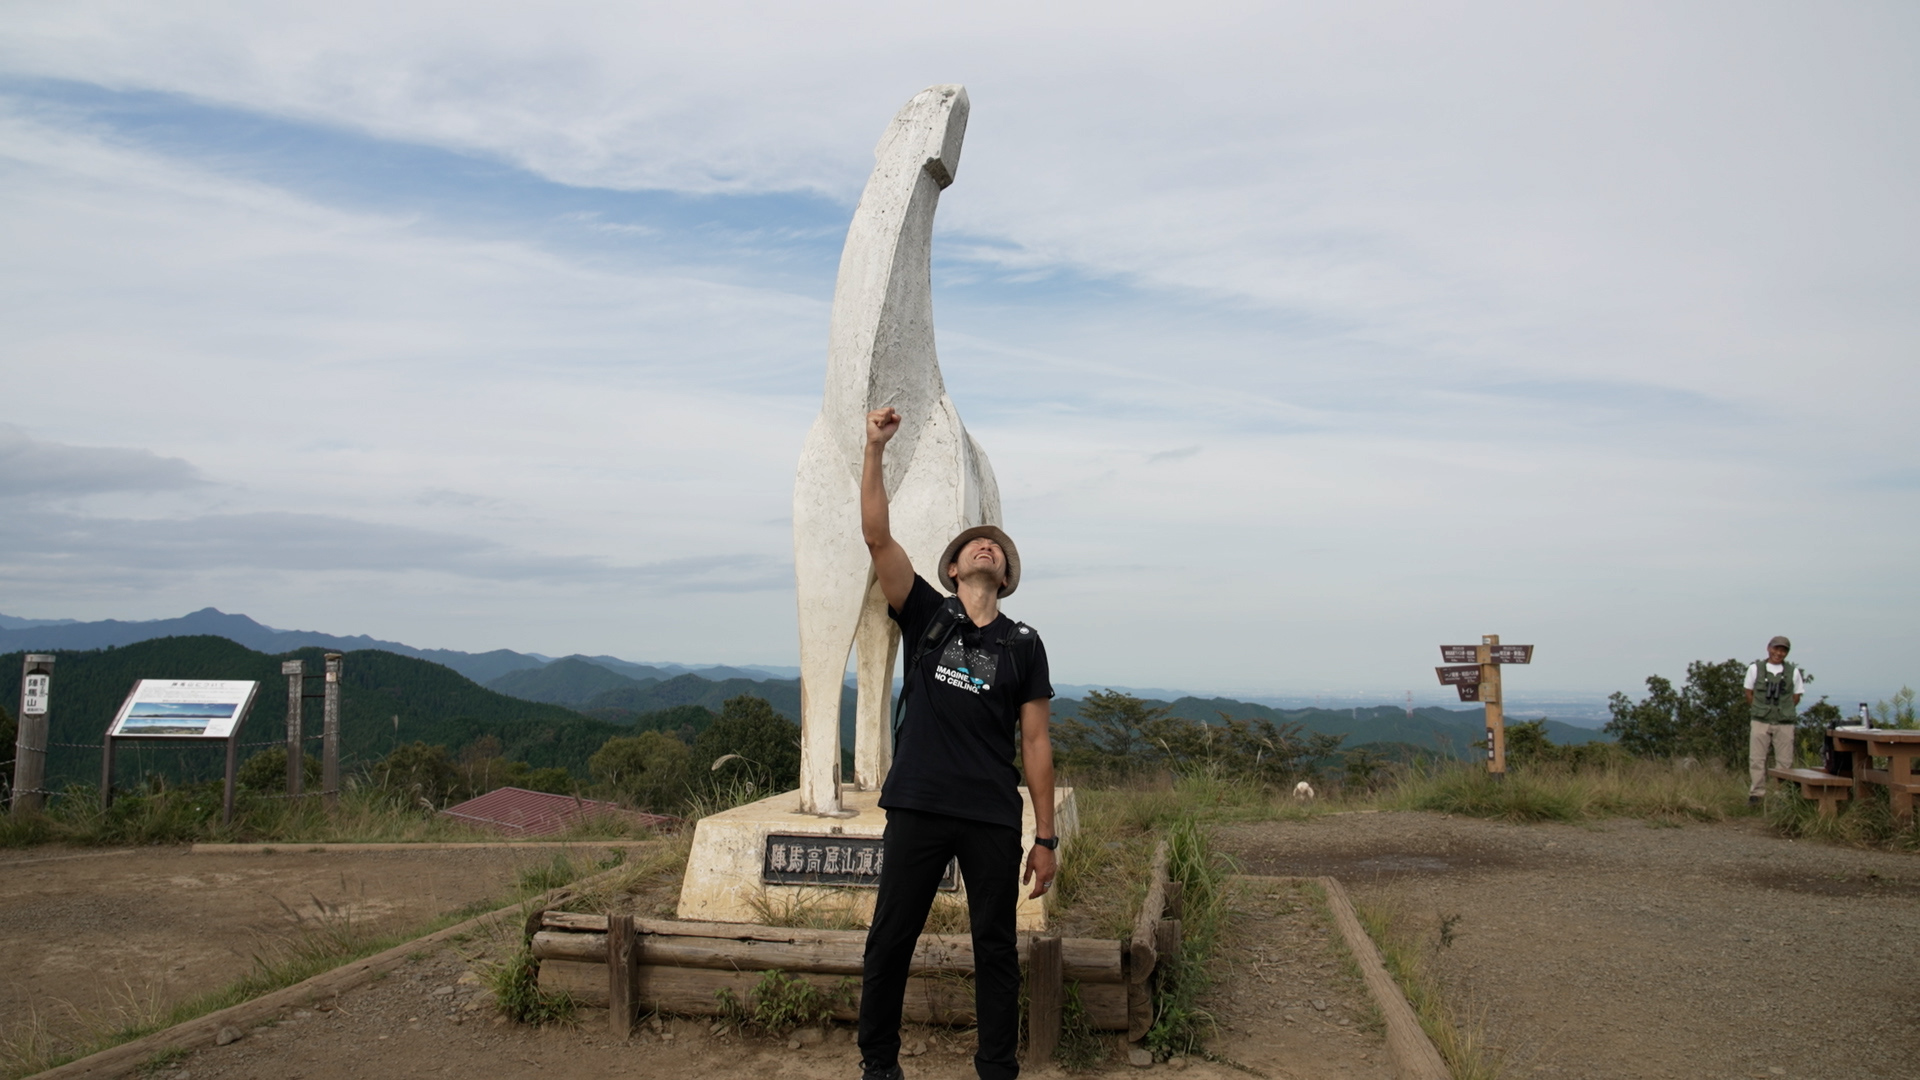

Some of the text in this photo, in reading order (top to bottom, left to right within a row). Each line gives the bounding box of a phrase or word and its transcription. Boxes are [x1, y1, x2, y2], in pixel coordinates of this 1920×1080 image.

[934, 672, 980, 694] NO CEILING.
[936, 665, 970, 683] IMAGINE.
